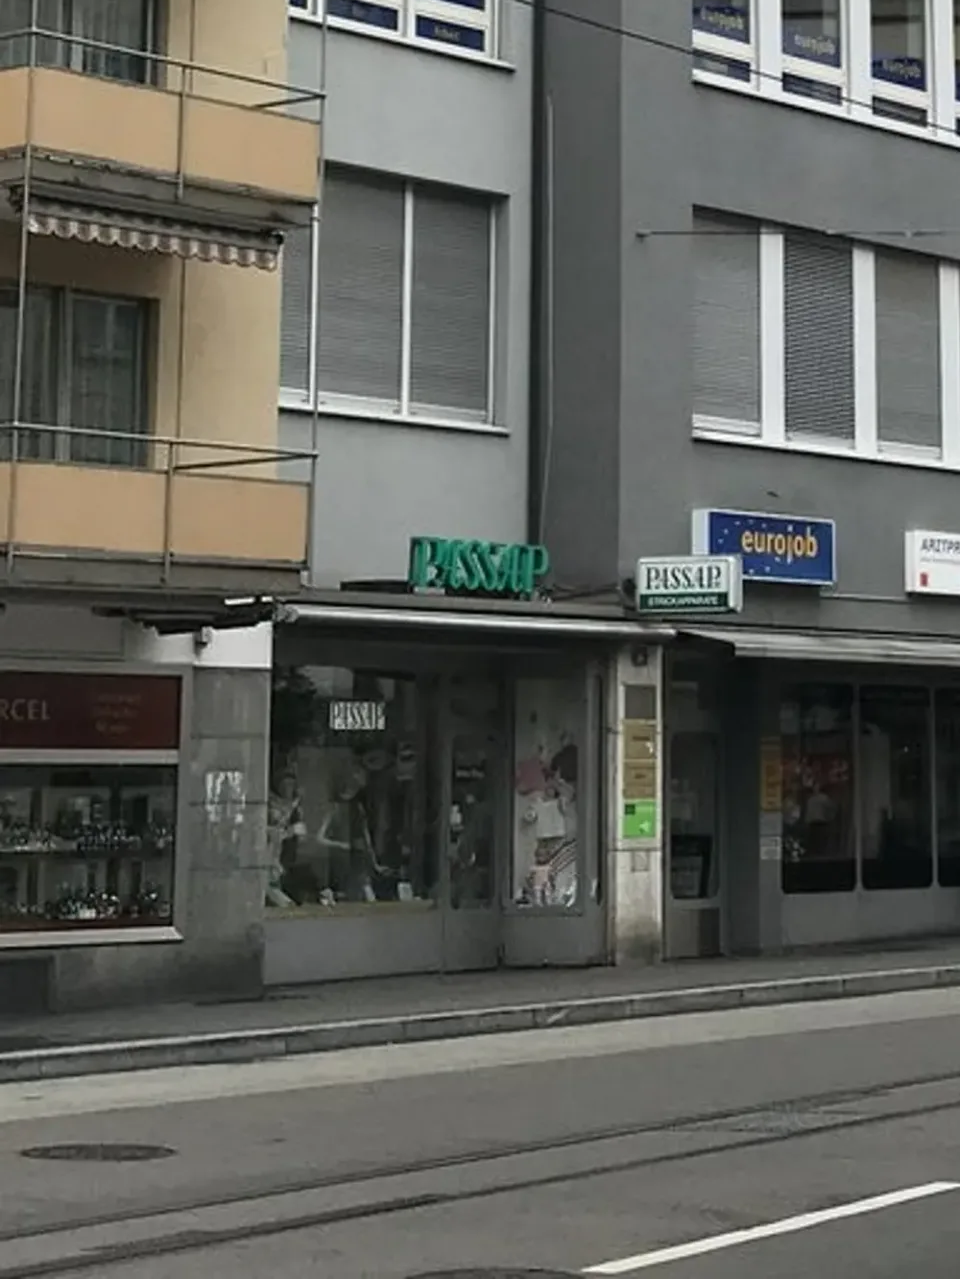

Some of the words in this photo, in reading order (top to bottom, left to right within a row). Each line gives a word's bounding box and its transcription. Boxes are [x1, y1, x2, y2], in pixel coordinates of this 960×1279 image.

[410, 537, 550, 593] PASSAP
[741, 524, 819, 565] eurojob
[645, 565, 722, 590] PASSAP
